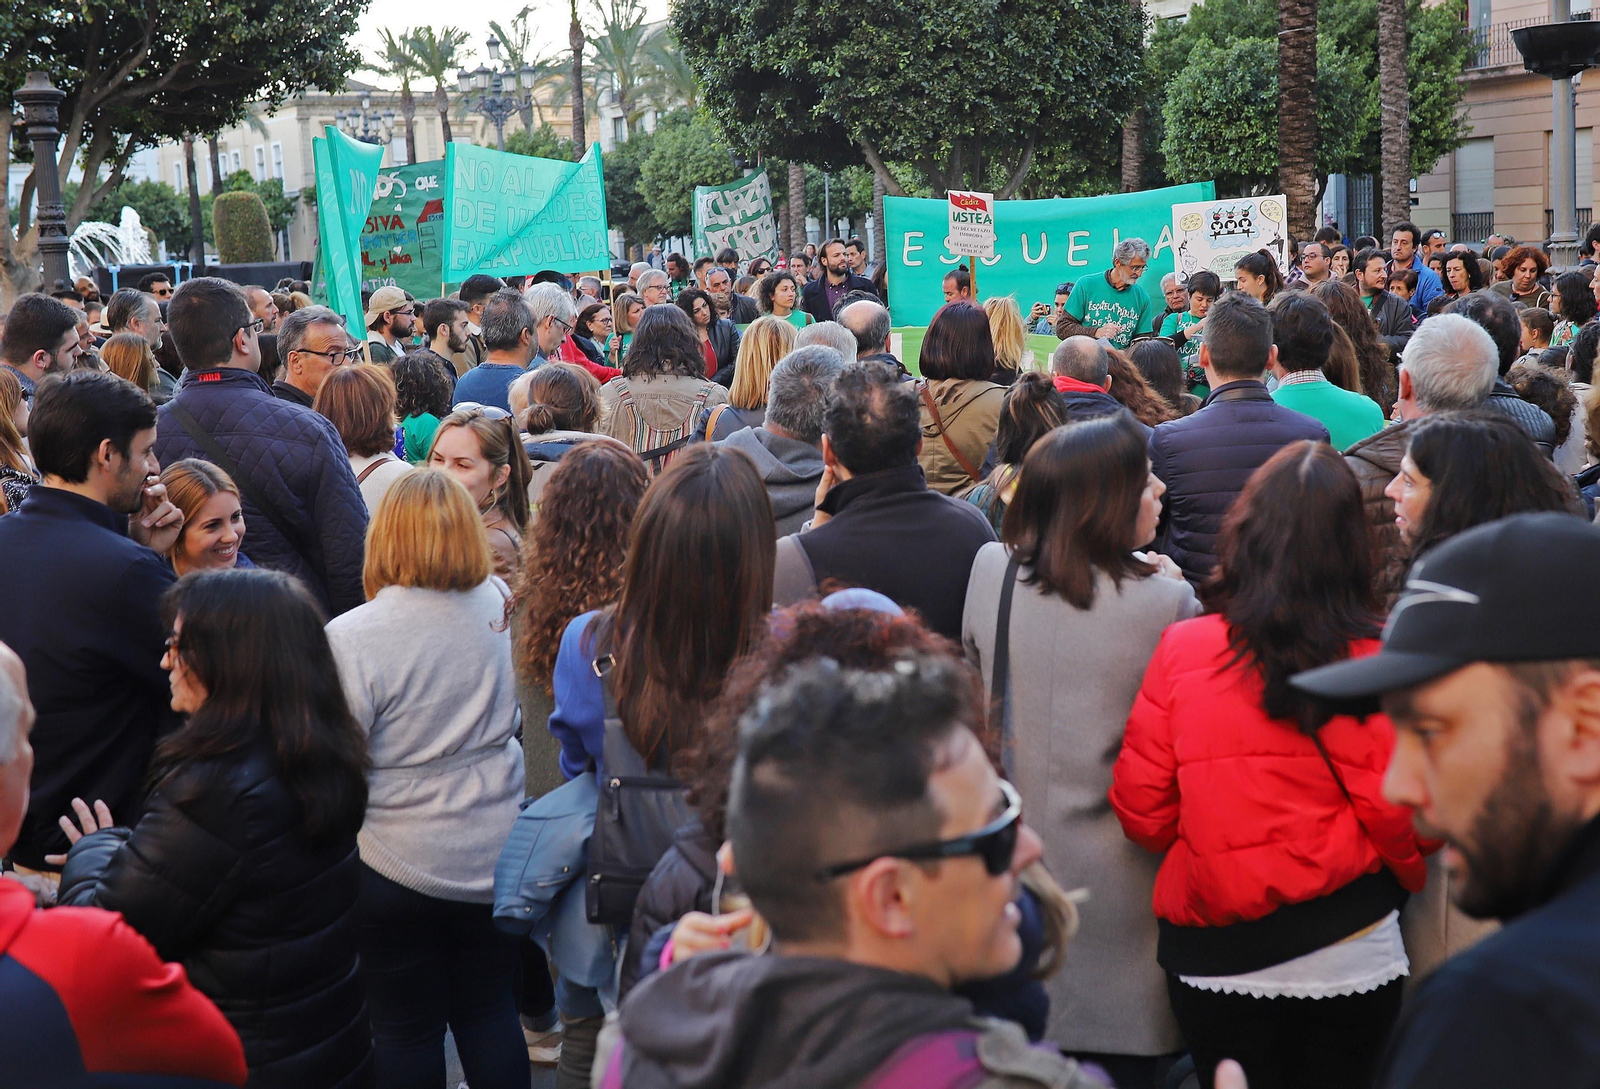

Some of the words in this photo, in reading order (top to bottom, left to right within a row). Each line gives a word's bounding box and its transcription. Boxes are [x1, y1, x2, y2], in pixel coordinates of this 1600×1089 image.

[415, 175, 439, 192] QUE
[454, 156, 495, 192] NO
[500, 165, 545, 199] AL
[960, 198, 980, 206] Cádiz
[362, 214, 405, 234] SIVA
[454, 197, 496, 235] DE
[952, 211, 992, 225] USTEA
[508, 226, 610, 267] PÚBLICA
[1088, 302, 1117, 314] ESCUELA
